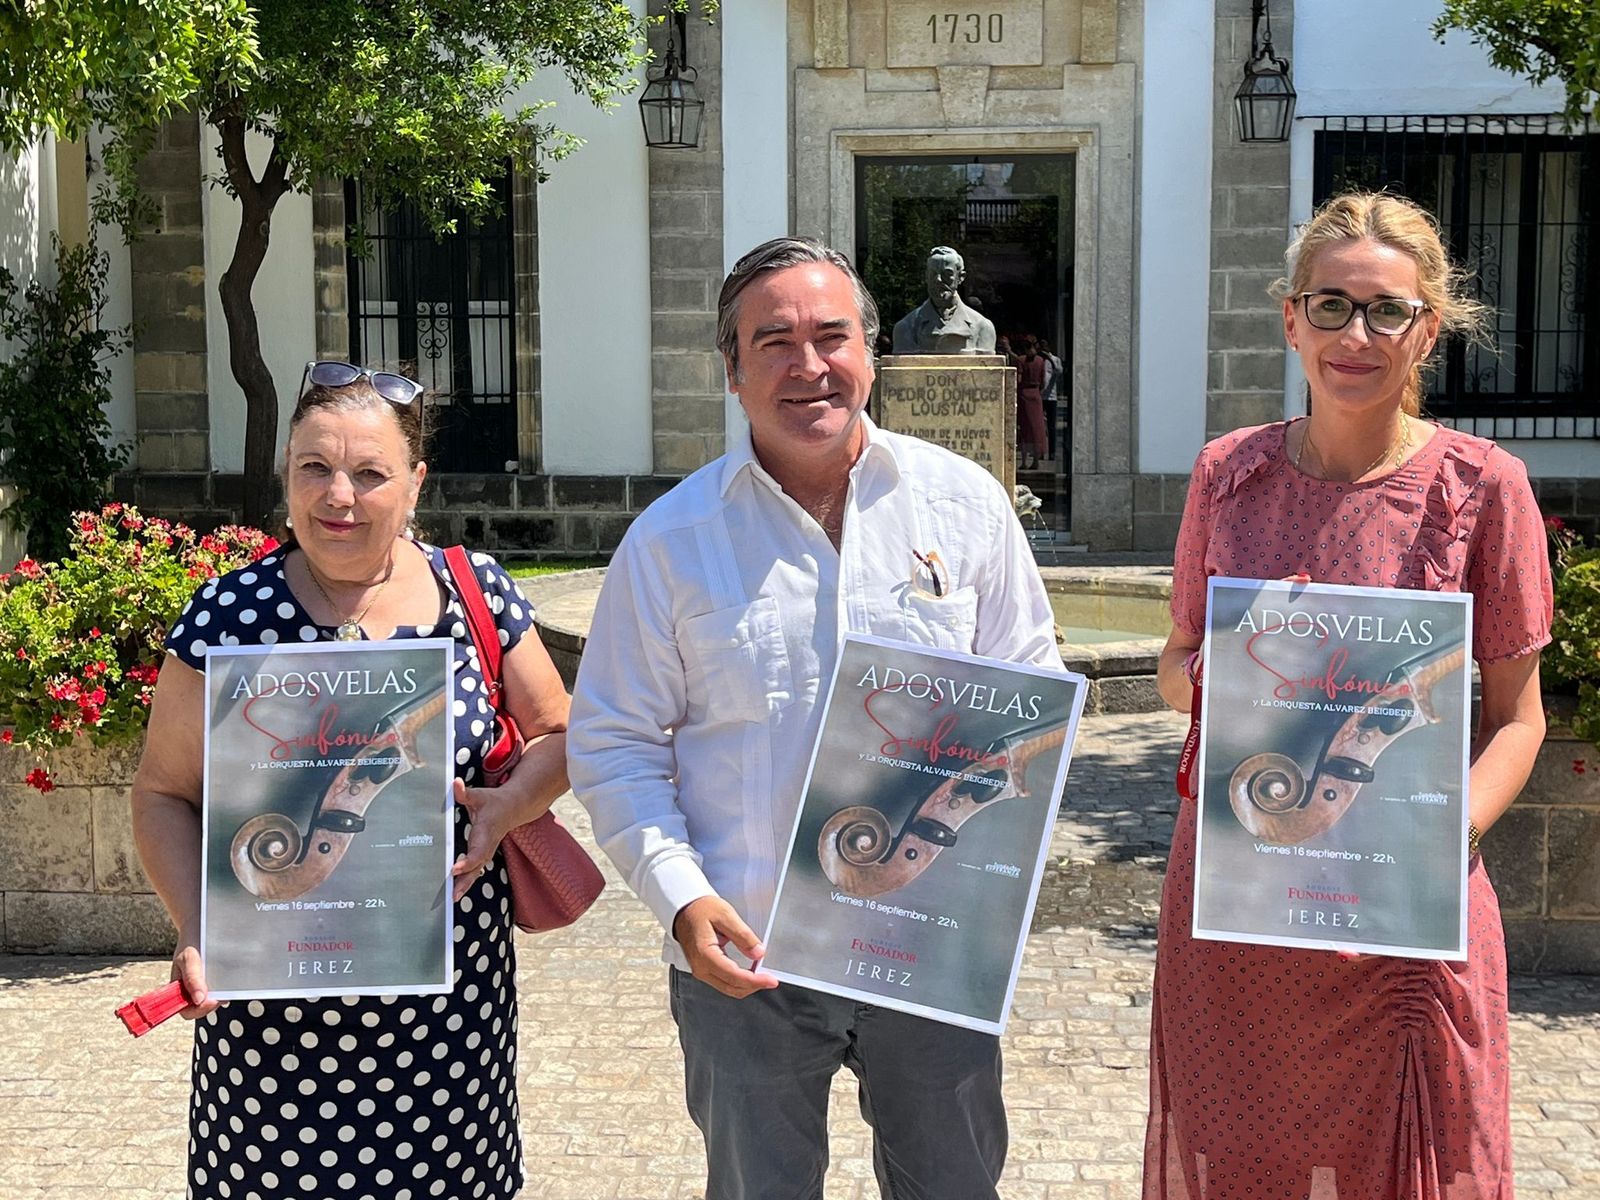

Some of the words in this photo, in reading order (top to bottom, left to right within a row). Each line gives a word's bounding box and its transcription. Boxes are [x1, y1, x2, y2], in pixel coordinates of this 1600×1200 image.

[926, 13, 1003, 44] 1730
[926, 374, 957, 387] DON
[887, 387, 936, 402] PEDRO
[911, 402, 977, 416] LOUSTAU
[1234, 608, 1434, 646] ADOSVELAS
[231, 668, 417, 699] ADOSVELAS
[857, 664, 1042, 721] ADOSVELAS
[1260, 698, 1272, 706] La
[1273, 700, 1322, 711] ORQUESTA
[1323, 703, 1366, 714] ALVAREZ
[1179, 719, 1201, 774] FUNDADOR
[257, 759, 269, 769] La
[269, 759, 315, 769] ORQUESTA
[316, 758, 356, 767] ALVAREZ
[865, 753, 876, 762] La
[877, 755, 922, 772] ORQUESTA
[923, 765, 962, 780] ALVAREZ
[1254, 843, 1291, 856] Viernes
[1293, 846, 1304, 856] 16
[1306, 847, 1362, 862] septiembre
[1288, 887, 1360, 904] FUNDADOR
[255, 902, 290, 912] Viernes
[292, 902, 302, 910] 16
[304, 900, 355, 911] septiembre
[830, 891, 863, 908] Viernes
[866, 900, 876, 910] 16
[877, 903, 928, 922] septiembre
[1287, 909, 1359, 928] JEREZ
[288, 941, 353, 952] FUNDADOR
[851, 938, 917, 963] FUNDADOR
[288, 960, 353, 977] JEREZ
[845, 960, 912, 987] JEREZ
